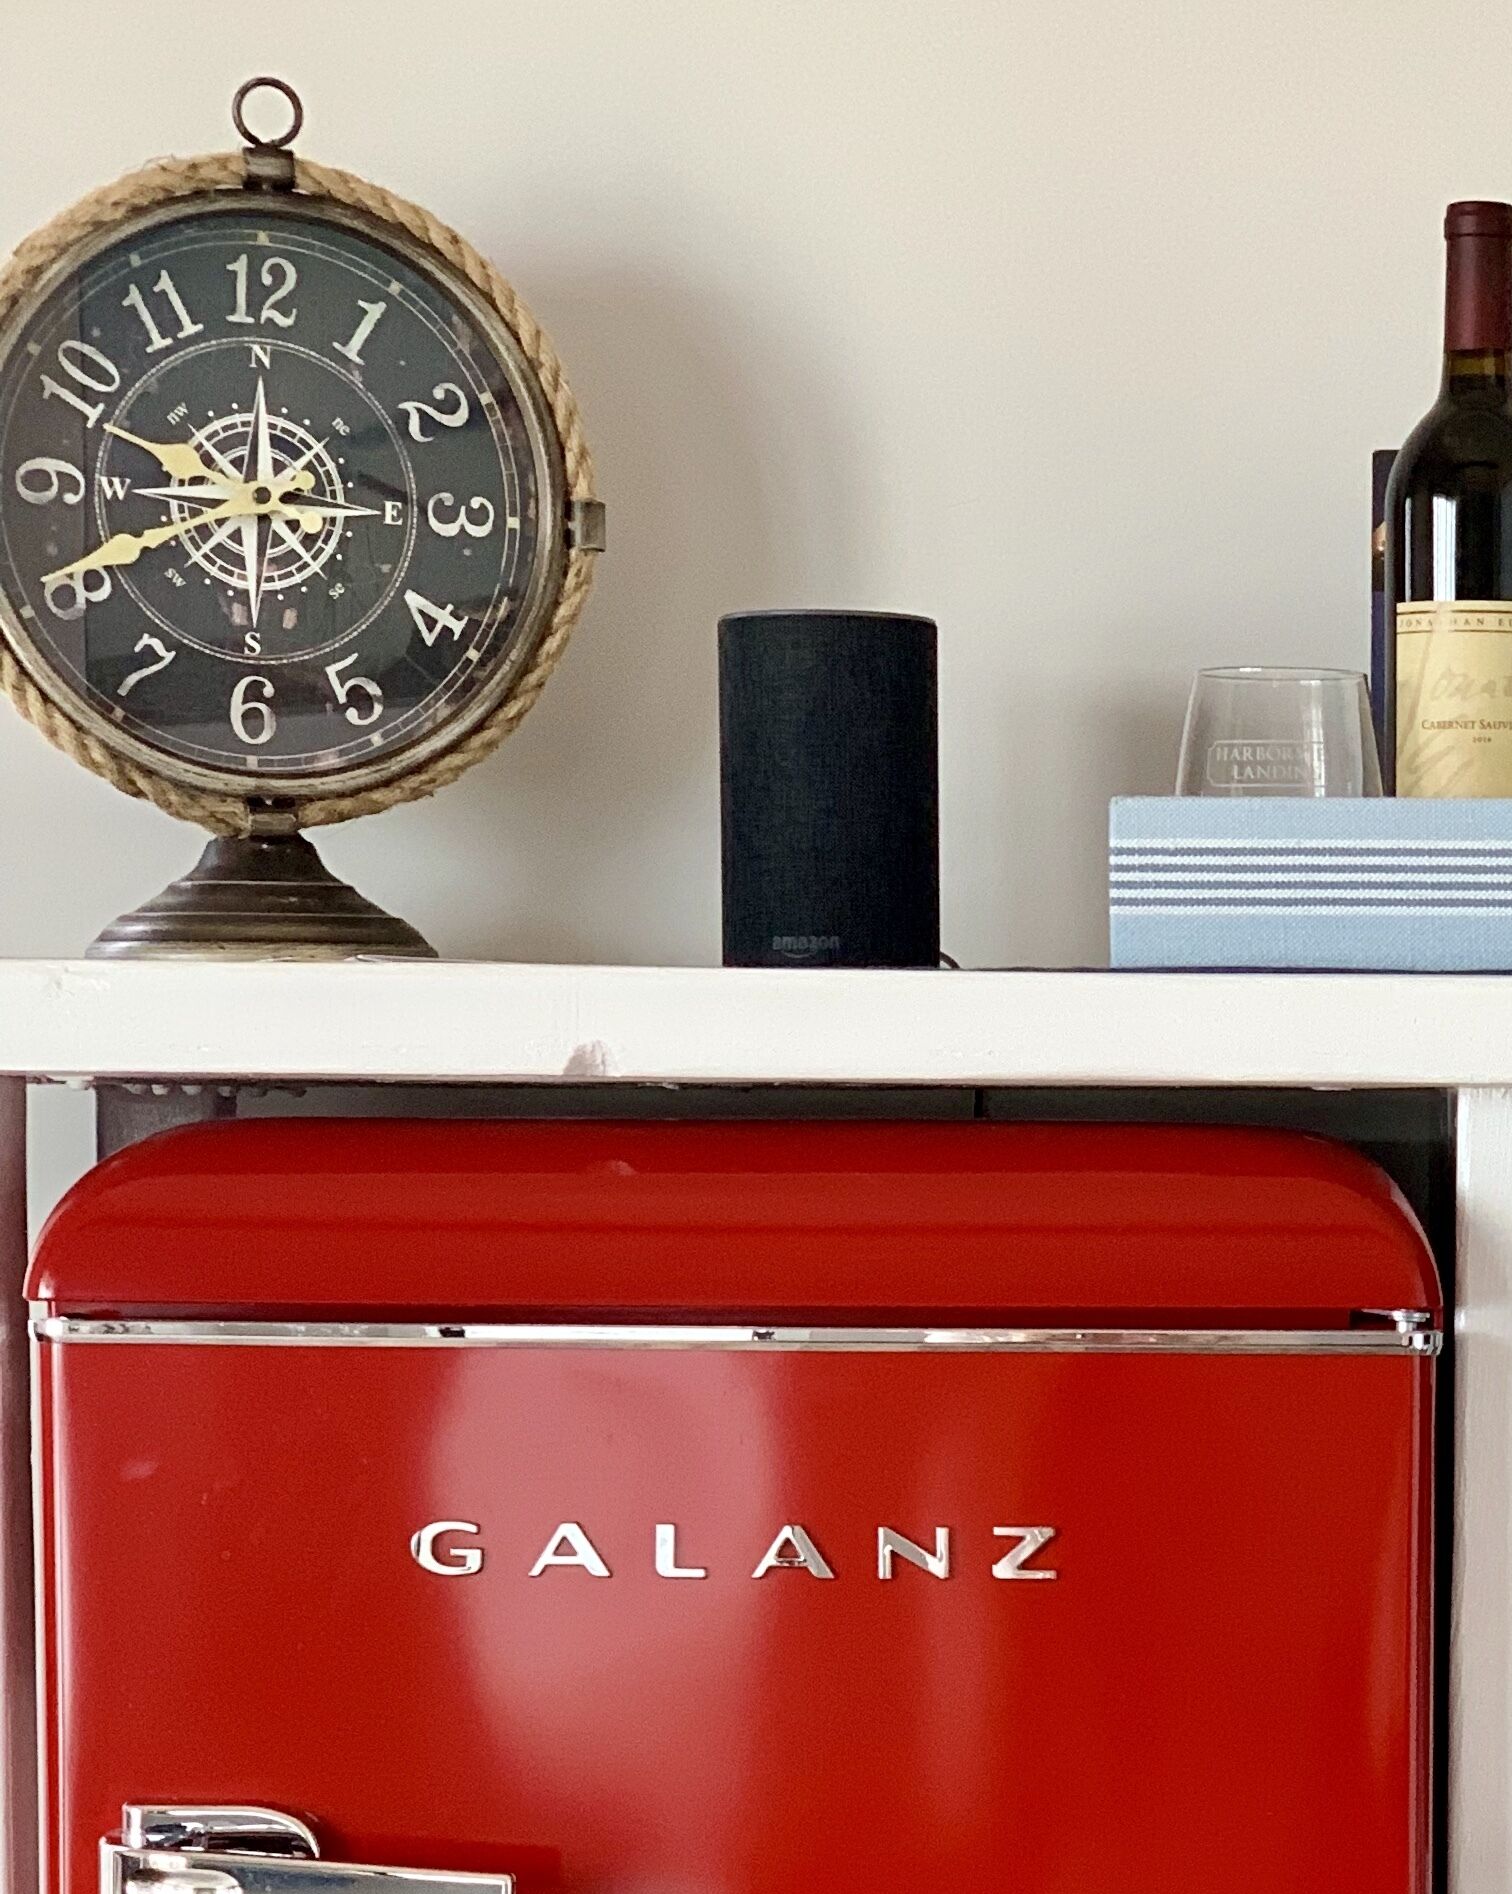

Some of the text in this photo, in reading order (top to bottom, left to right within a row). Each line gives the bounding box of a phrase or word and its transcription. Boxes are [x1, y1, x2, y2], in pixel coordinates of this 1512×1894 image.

[122, 269, 204, 353] 11
[225, 253, 298, 328] 12
[249, 344, 271, 370] N
[332, 299, 387, 366] 1
[40, 339, 121, 429] 10
[397, 382, 469, 442] 2
[15, 457, 86, 504] 9
[100, 476, 131, 500] W
[384, 501, 403, 525] E
[427, 492, 495, 537] 3
[44, 565, 112, 620] 8
[404, 588, 469, 647] 4
[244, 632, 261, 656] S
[1399, 616, 1486, 629] JONAHAN
[117, 633, 176, 697] 7
[325, 653, 384, 725] 5
[230, 675, 277, 744] 6
[1421, 719, 1476, 731] CABERNET
[772, 935, 841, 950] amazon
[410, 1520, 1058, 1580] GALANZ
